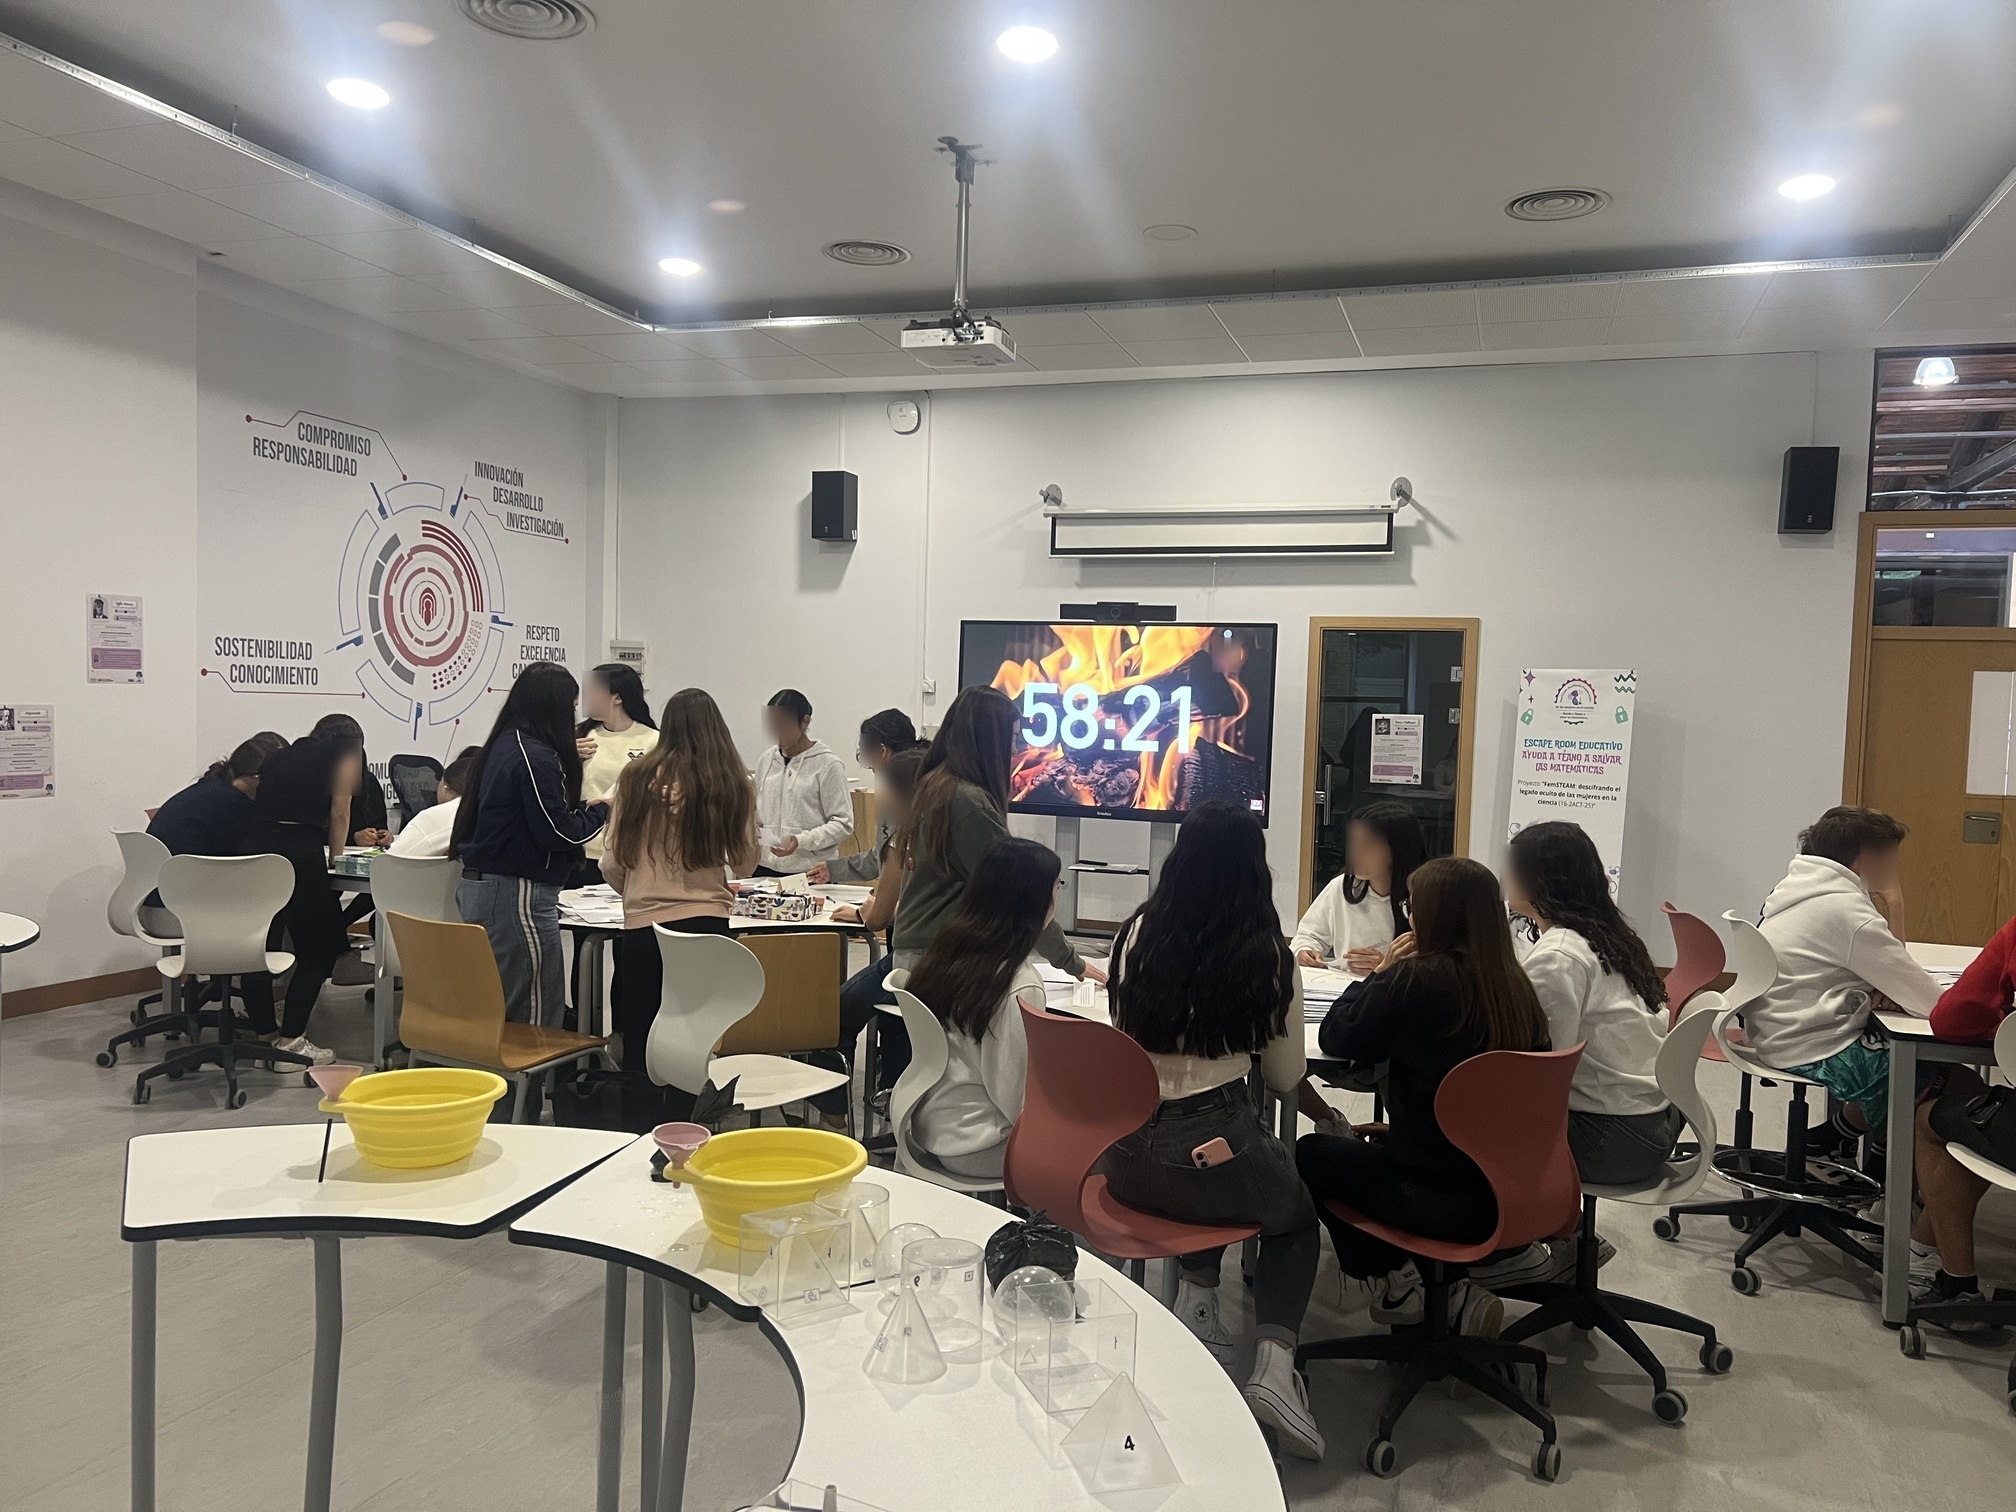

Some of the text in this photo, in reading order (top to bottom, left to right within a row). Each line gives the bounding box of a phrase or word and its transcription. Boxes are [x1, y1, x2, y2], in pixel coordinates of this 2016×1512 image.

[298, 421, 371, 457] COMPROMISO
[253, 436, 358, 477] RESPONSABILIDAD
[474, 460, 524, 488] INNOVACIÓN
[493, 486, 544, 512] DESARROLLO
[506, 511, 564, 537] INVESTIGACIÓN
[526, 625, 560, 642] RESPETO
[215, 636, 312, 660] SOSTENIBILIDAD
[520, 644, 566, 663] EXCELENCIA
[230, 663, 318, 686] CONOCIMIENTO
[1022, 682, 1192, 753] 58:21
[1524, 739, 1623, 751] ESCAPE ROOM EDUCATIVO
[1521, 749, 1547, 760] AYUDA
[1549, 752, 1555, 761] A
[1584, 753, 1590, 763] A
[1592, 754, 1622, 765] SALVAR
[1535, 762, 1548, 772] LAS
[1517, 779, 1540, 787] Proyecto
[1578, 784, 1614, 792] descifrando
[1519, 788, 1538, 796] legado
[1576, 793, 1601, 801] mujeres
[1123, 1434, 1136, 1451] 4
